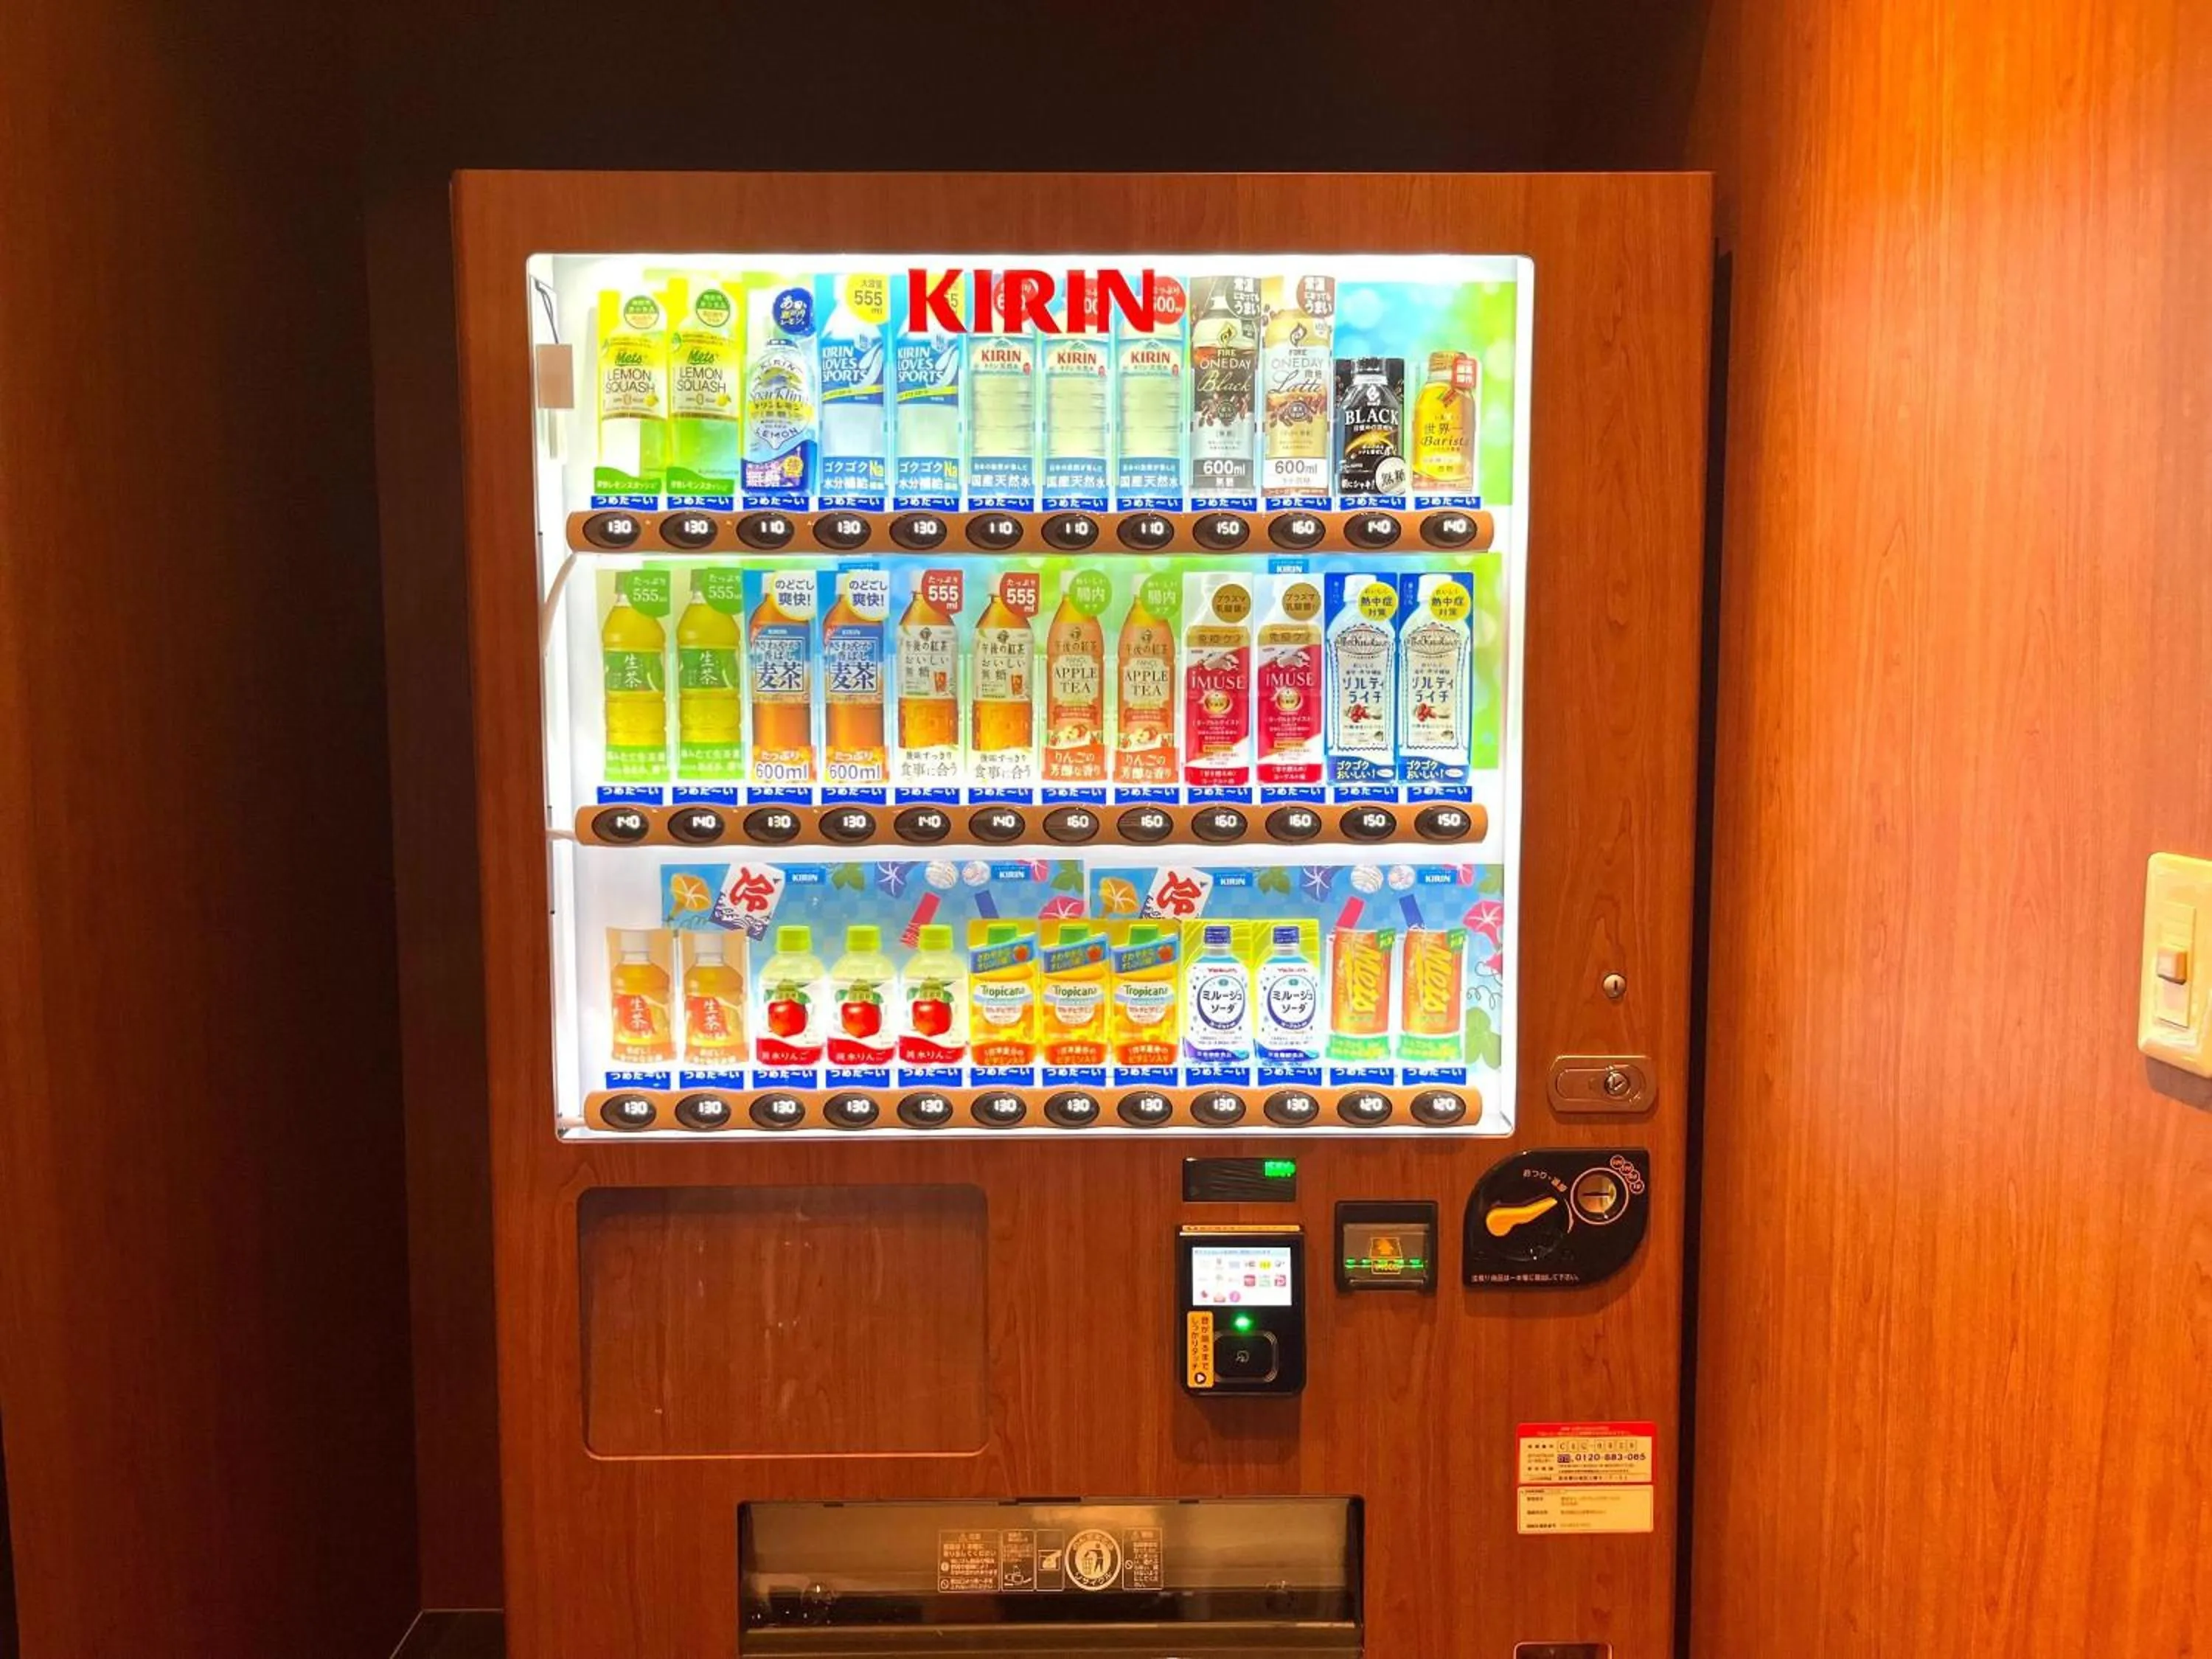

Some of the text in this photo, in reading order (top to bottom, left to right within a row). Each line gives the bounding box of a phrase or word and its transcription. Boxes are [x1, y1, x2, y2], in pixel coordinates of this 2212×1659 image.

[855, 291, 883, 306] 555
[908, 269, 1154, 333] KIRIN
[822, 346, 855, 358] KIRIN
[897, 347, 931, 359] KIRIN
[981, 349, 1022, 362] KIRIN
[1057, 352, 1097, 364] KIRIN
[1130, 350, 1171, 364] KIRIN
[607, 369, 651, 381] LEMON
[679, 366, 723, 380] LEMON
[822, 369, 868, 383] SPORTS
[897, 370, 945, 383] SPORTS
[677, 380, 726, 393] SQUASH
[1197, 368, 1253, 392] Black
[605, 381, 655, 394] SQUASH
[1346, 408, 1399, 426] BLACK
[824, 461, 868, 473] ゴクゴク
[899, 462, 942, 473] ゴクゴク
[1203, 459, 1246, 476] 600ml
[1275, 459, 1318, 475] 600ml
[971, 475, 1031, 487] 国産天然水
[1046, 476, 1106, 489] 国産天然水
[1119, 476, 1179, 488] 国産天然水
[609, 521, 631, 533] 130
[685, 521, 708, 533] 130
[762, 521, 784, 533] 110
[838, 521, 860, 534] 130
[914, 521, 936, 534] 130
[990, 522, 1012, 535] 110
[1065, 522, 1088, 535] 110
[1141, 522, 1164, 535] 110
[1217, 521, 1239, 535] 150
[1293, 521, 1315, 535] 160
[1368, 520, 1391, 533] 140
[1443, 519, 1466, 533] 140
[775, 580, 815, 591] のどごし
[849, 580, 888, 591] のどごし
[633, 589, 658, 602] 555
[708, 586, 734, 599] 555
[928, 585, 959, 602] 555
[1006, 588, 1036, 605] 555
[625, 653, 642, 688] 生茶
[700, 650, 717, 685] 生茶
[1055, 667, 1098, 679] APPLE
[757, 661, 802, 689] 麦茶
[831, 661, 876, 689] 麦茶
[1125, 669, 1169, 682] APPLE
[1060, 681, 1092, 694] TEA
[1132, 684, 1163, 697] TEA
[1349, 691, 1382, 704] ライチ
[1415, 691, 1449, 703] ライチ
[1055, 751, 1095, 763] りんごの
[1124, 754, 1166, 767] りんごの
[756, 763, 807, 779] 600ml
[1337, 759, 1369, 771] ゴクゴク
[1406, 759, 1439, 771] ゴクゴク
[830, 764, 880, 780] 600ml
[616, 815, 640, 828] 140
[692, 815, 716, 828] 140
[768, 815, 791, 828] 130
[844, 815, 866, 828] 130
[919, 815, 941, 827] 140
[993, 815, 1015, 827] 140
[1067, 815, 1089, 828] 160
[1141, 815, 1163, 828] 160
[1214, 815, 1237, 827] 160
[1290, 814, 1312, 827] 160
[1363, 814, 1385, 827] 150
[1438, 813, 1460, 827] 150
[792, 873, 818, 882] KIRIN
[999, 870, 1025, 878] KIRIN
[1425, 874, 1450, 883] KIRIN
[1220, 877, 1245, 886] KIRIN
[980, 984, 1026, 996] Tropicana
[1052, 984, 1098, 996] Tropicana
[1123, 984, 1169, 996] Tropicana
[1203, 990, 1242, 1001] ミルージュ
[1272, 990, 1313, 1001] ミルージュ
[1211, 1003, 1237, 1014] ソーダ
[1281, 1003, 1307, 1014] ソーダ
[625, 1102, 647, 1114] 130
[699, 1101, 722, 1114] 130
[773, 1101, 796, 1114] 130
[847, 1100, 870, 1113] 130
[921, 1099, 943, 1113] 130
[994, 1099, 1017, 1112] 130
[1067, 1099, 1089, 1112] 130
[1141, 1099, 1163, 1111] 130
[1214, 1099, 1236, 1111] 130
[1287, 1099, 1309, 1111] 130
[1360, 1099, 1382, 1111] 120
[1433, 1098, 1456, 1111] 120
